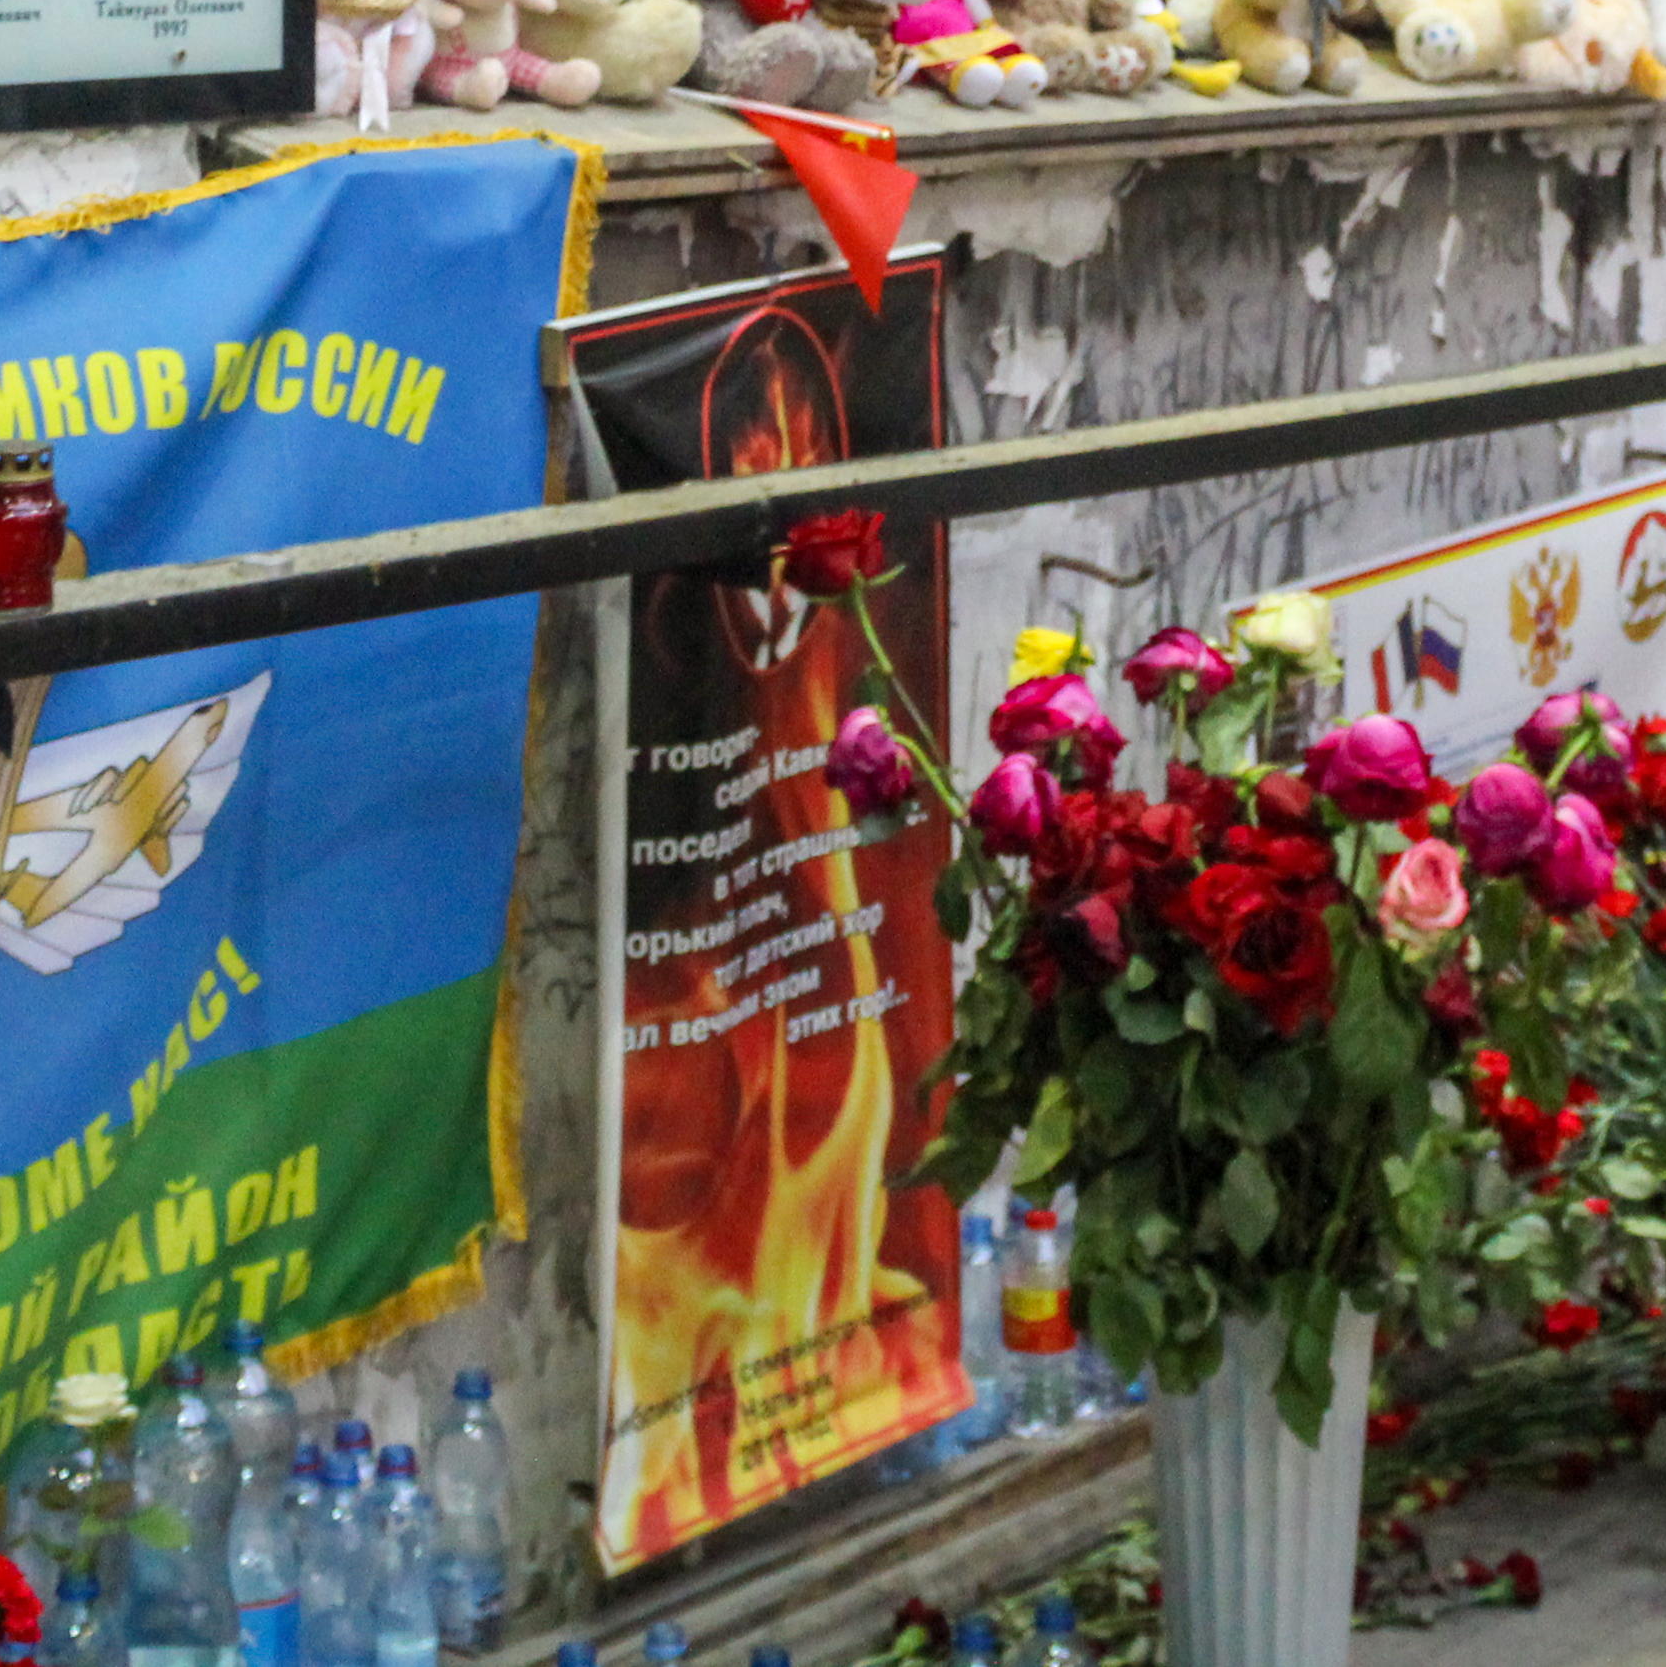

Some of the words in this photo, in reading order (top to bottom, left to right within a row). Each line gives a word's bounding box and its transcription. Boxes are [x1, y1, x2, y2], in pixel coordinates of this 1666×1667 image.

[626, 910, 736, 966] орький
[129, 936, 262, 1138] НАС!
[69, 1145, 319, 1317] РАЙОН
